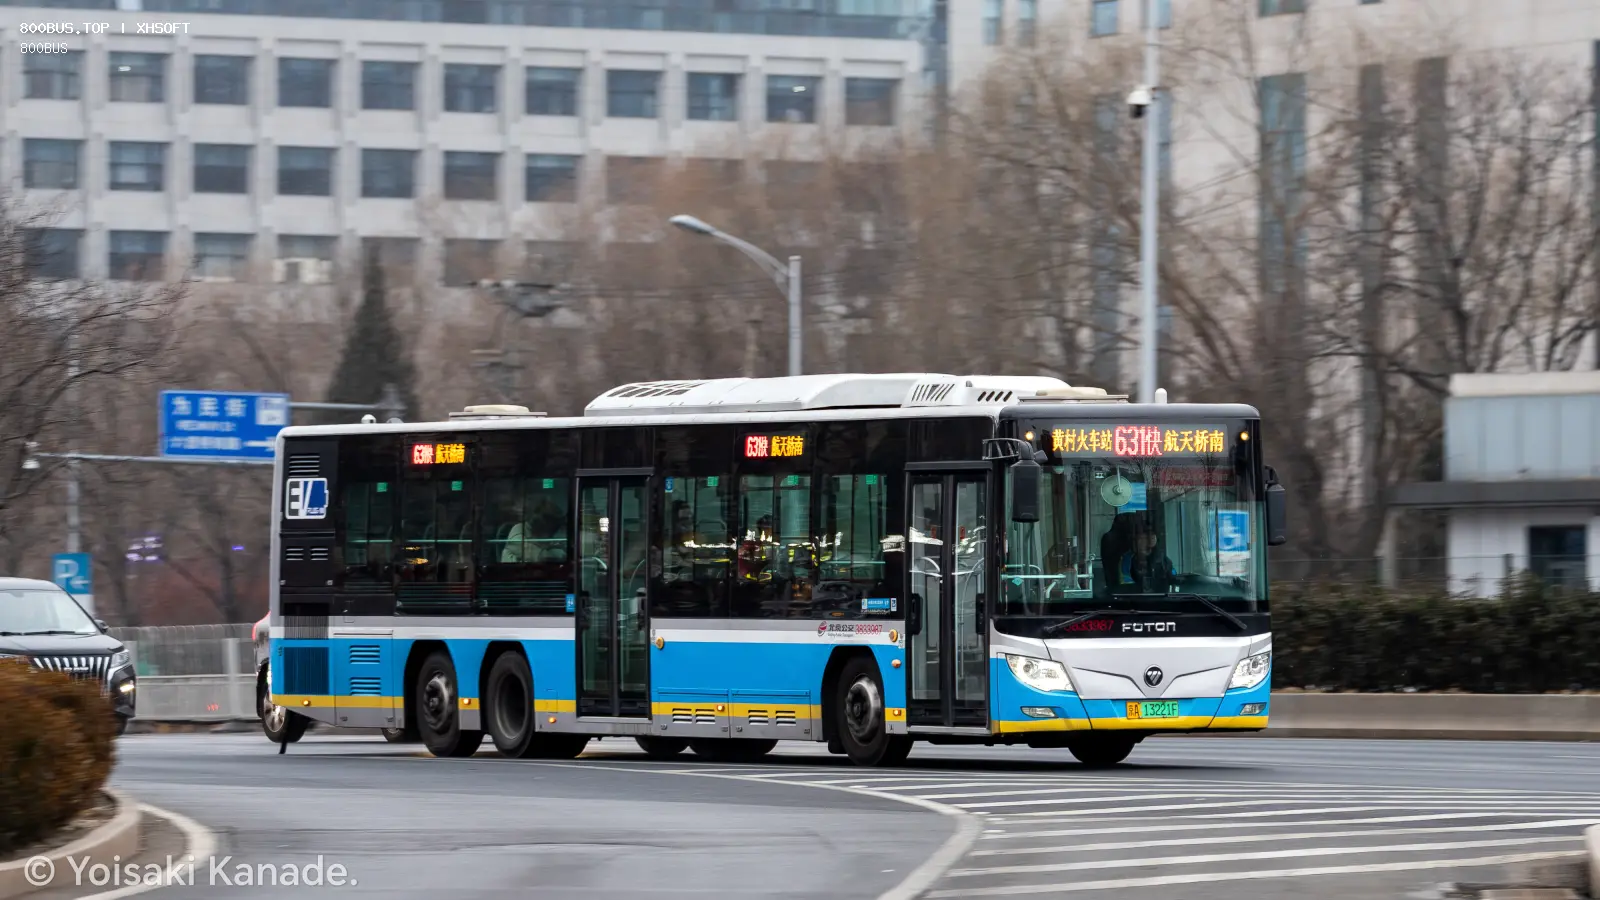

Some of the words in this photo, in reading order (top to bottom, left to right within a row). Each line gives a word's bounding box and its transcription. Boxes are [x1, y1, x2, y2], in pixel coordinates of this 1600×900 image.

[771, 435, 804, 457] 航天桥南
[1051, 428, 1113, 452] 黄村火车站
[1114, 425, 1163, 456] 631快
[1164, 429, 1224, 453] 航天桥南
[55, 559, 79, 586] P
[828, 623, 854, 632] 北京公交
[1121, 621, 1177, 633] FOTON
[1128, 704, 1140, 717] 京A
[1144, 703, 1177, 717] 13221F
